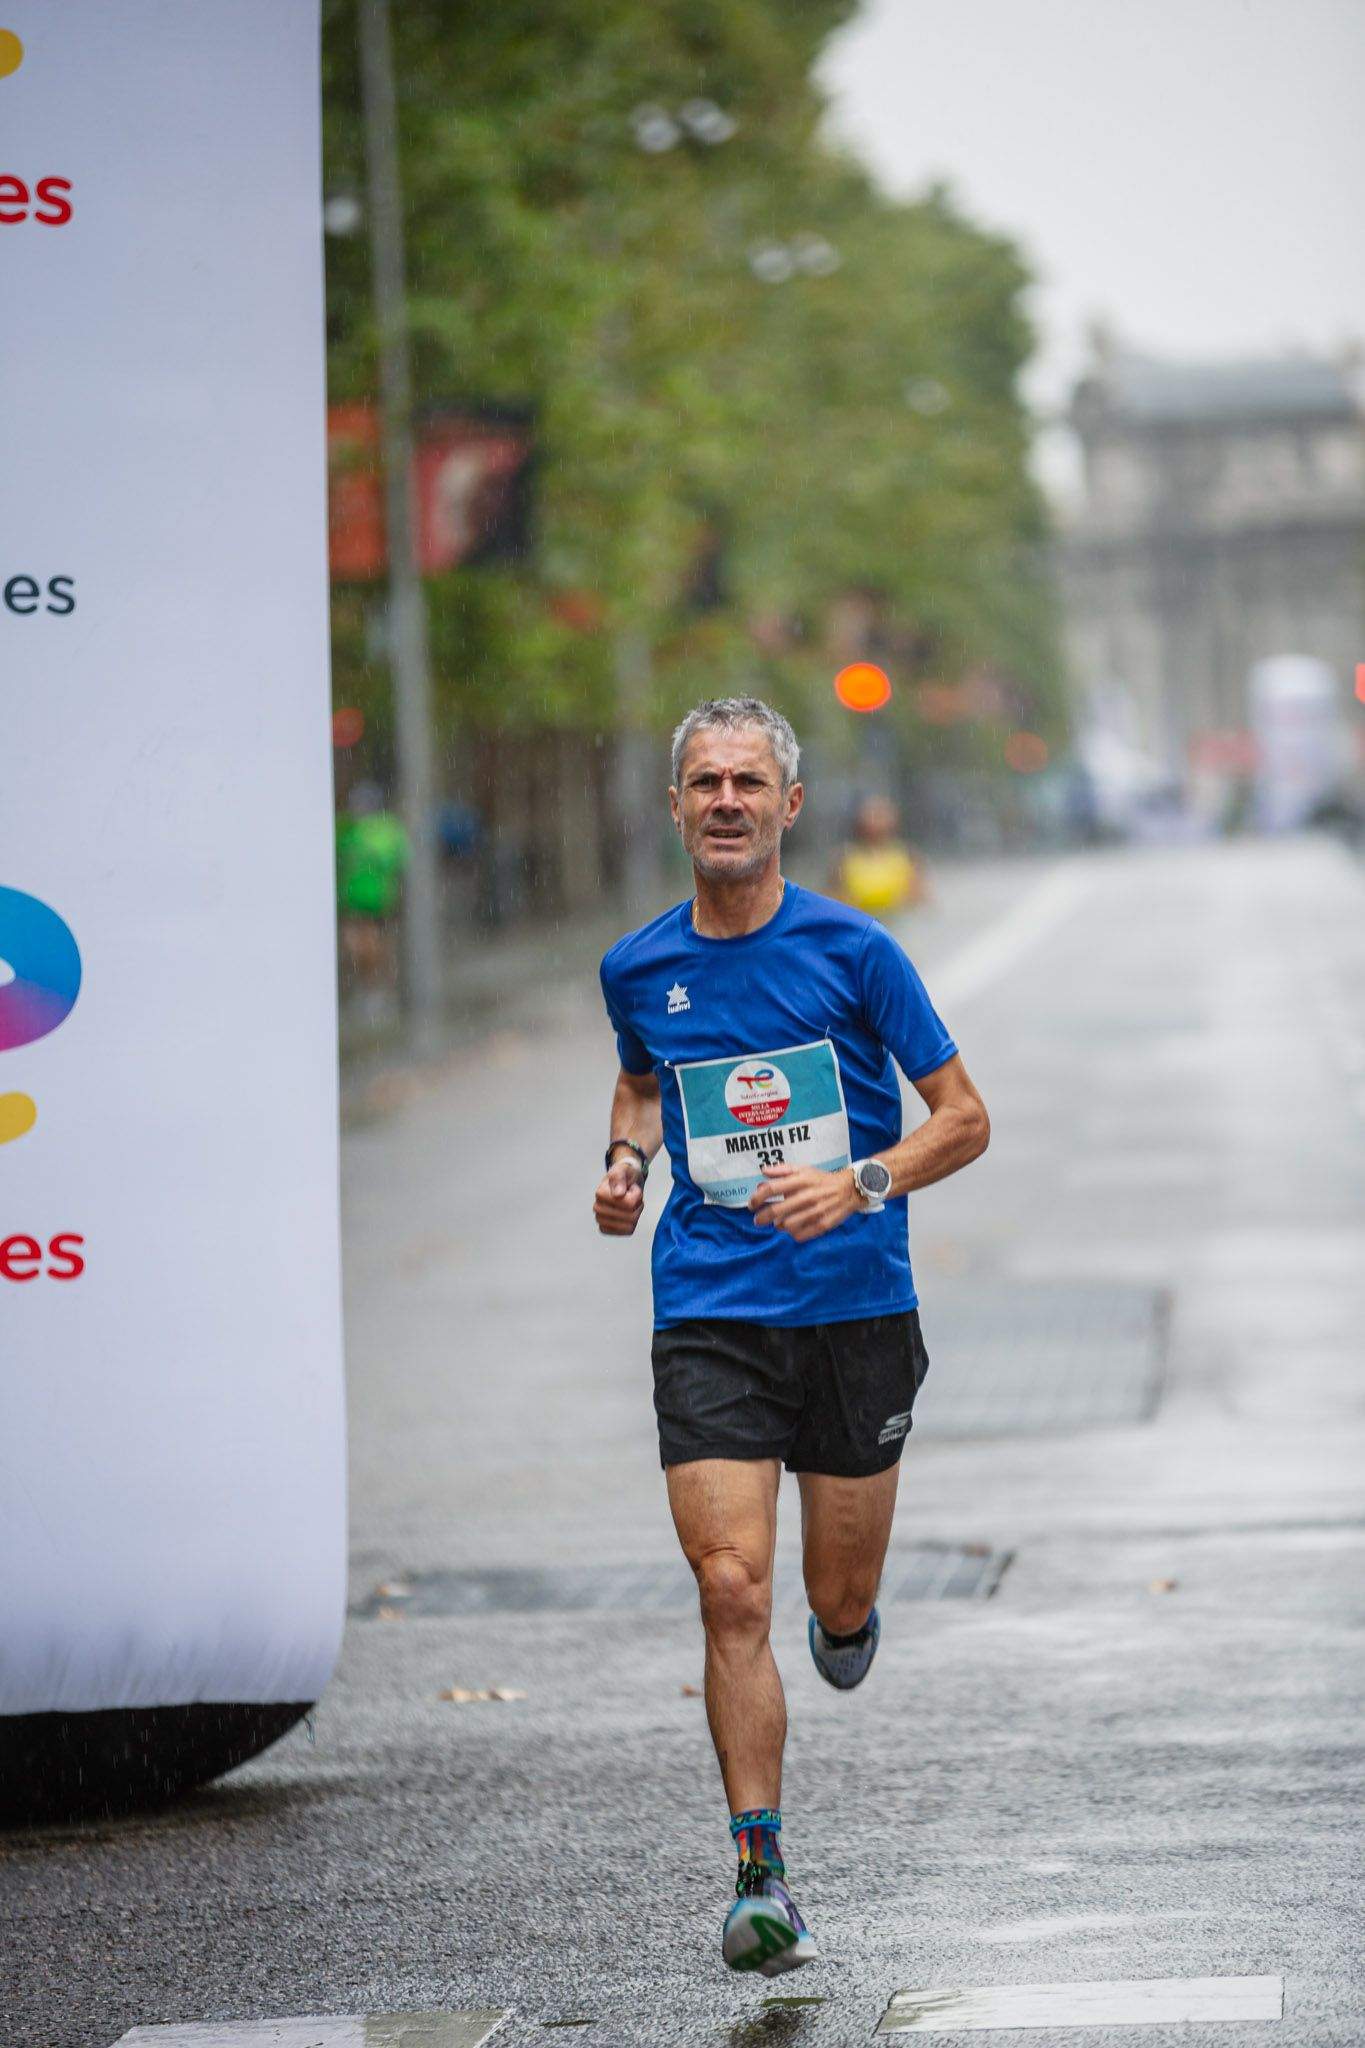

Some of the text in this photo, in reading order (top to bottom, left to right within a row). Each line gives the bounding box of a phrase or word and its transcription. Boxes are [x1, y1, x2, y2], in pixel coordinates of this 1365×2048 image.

[0, 175, 72, 225] es
[4, 575, 76, 615] es
[725, 1124, 811, 1154] MARTÍN FIZ
[713, 1187, 748, 1199] MADRID
[0, 1232, 85, 1283] es
